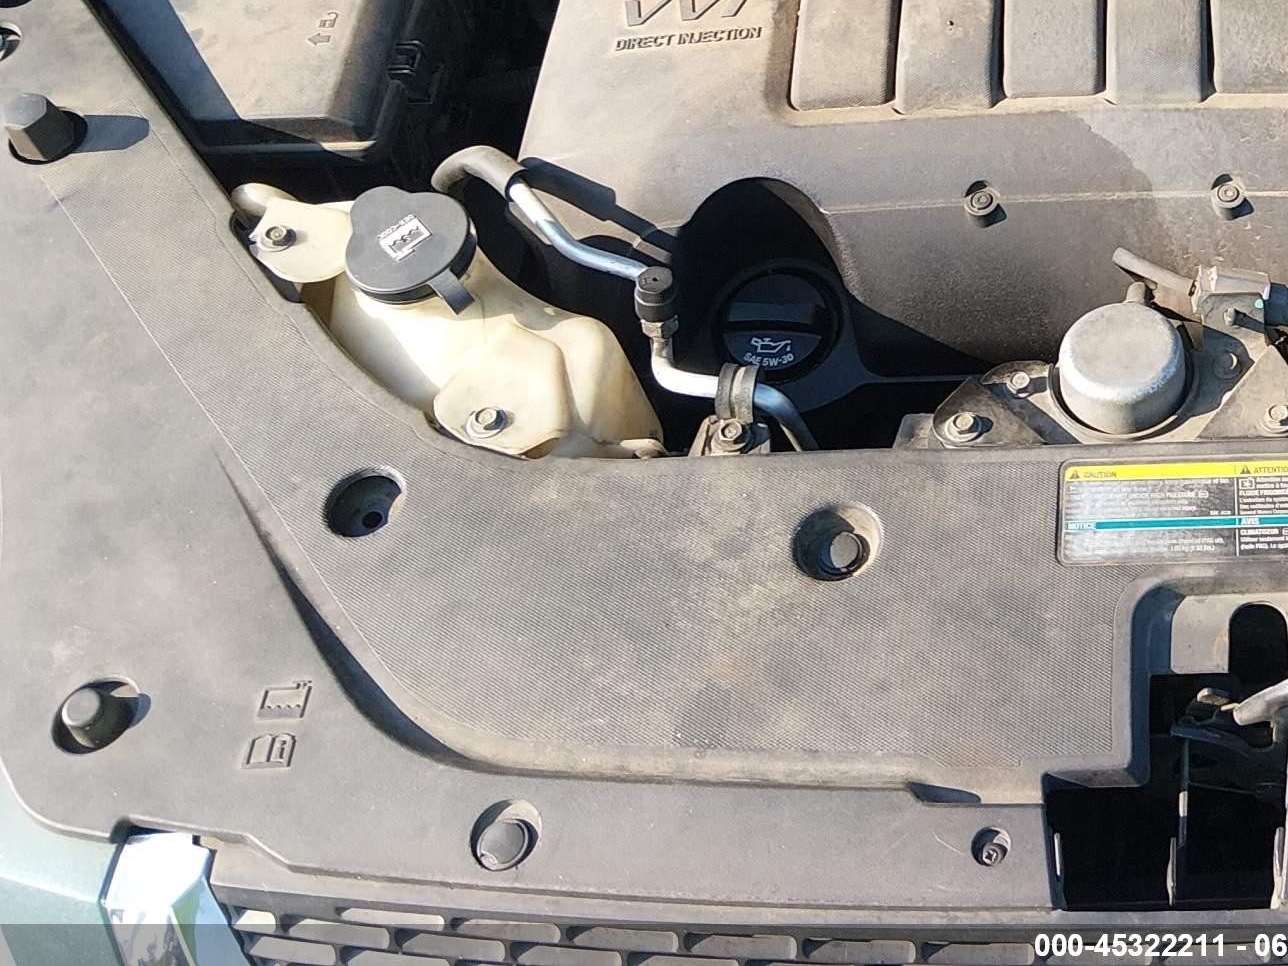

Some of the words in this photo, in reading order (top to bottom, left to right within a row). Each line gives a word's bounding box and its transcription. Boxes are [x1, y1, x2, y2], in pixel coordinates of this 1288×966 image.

[615, 34, 675, 52] DIRECT
[677, 26, 762, 46] INJECTION
[743, 352, 761, 365] SAE
[762, 353, 794, 367] 5W-30
[1067, 522, 1096, 530] NOTICE
[1241, 517, 1260, 526] AVIS
